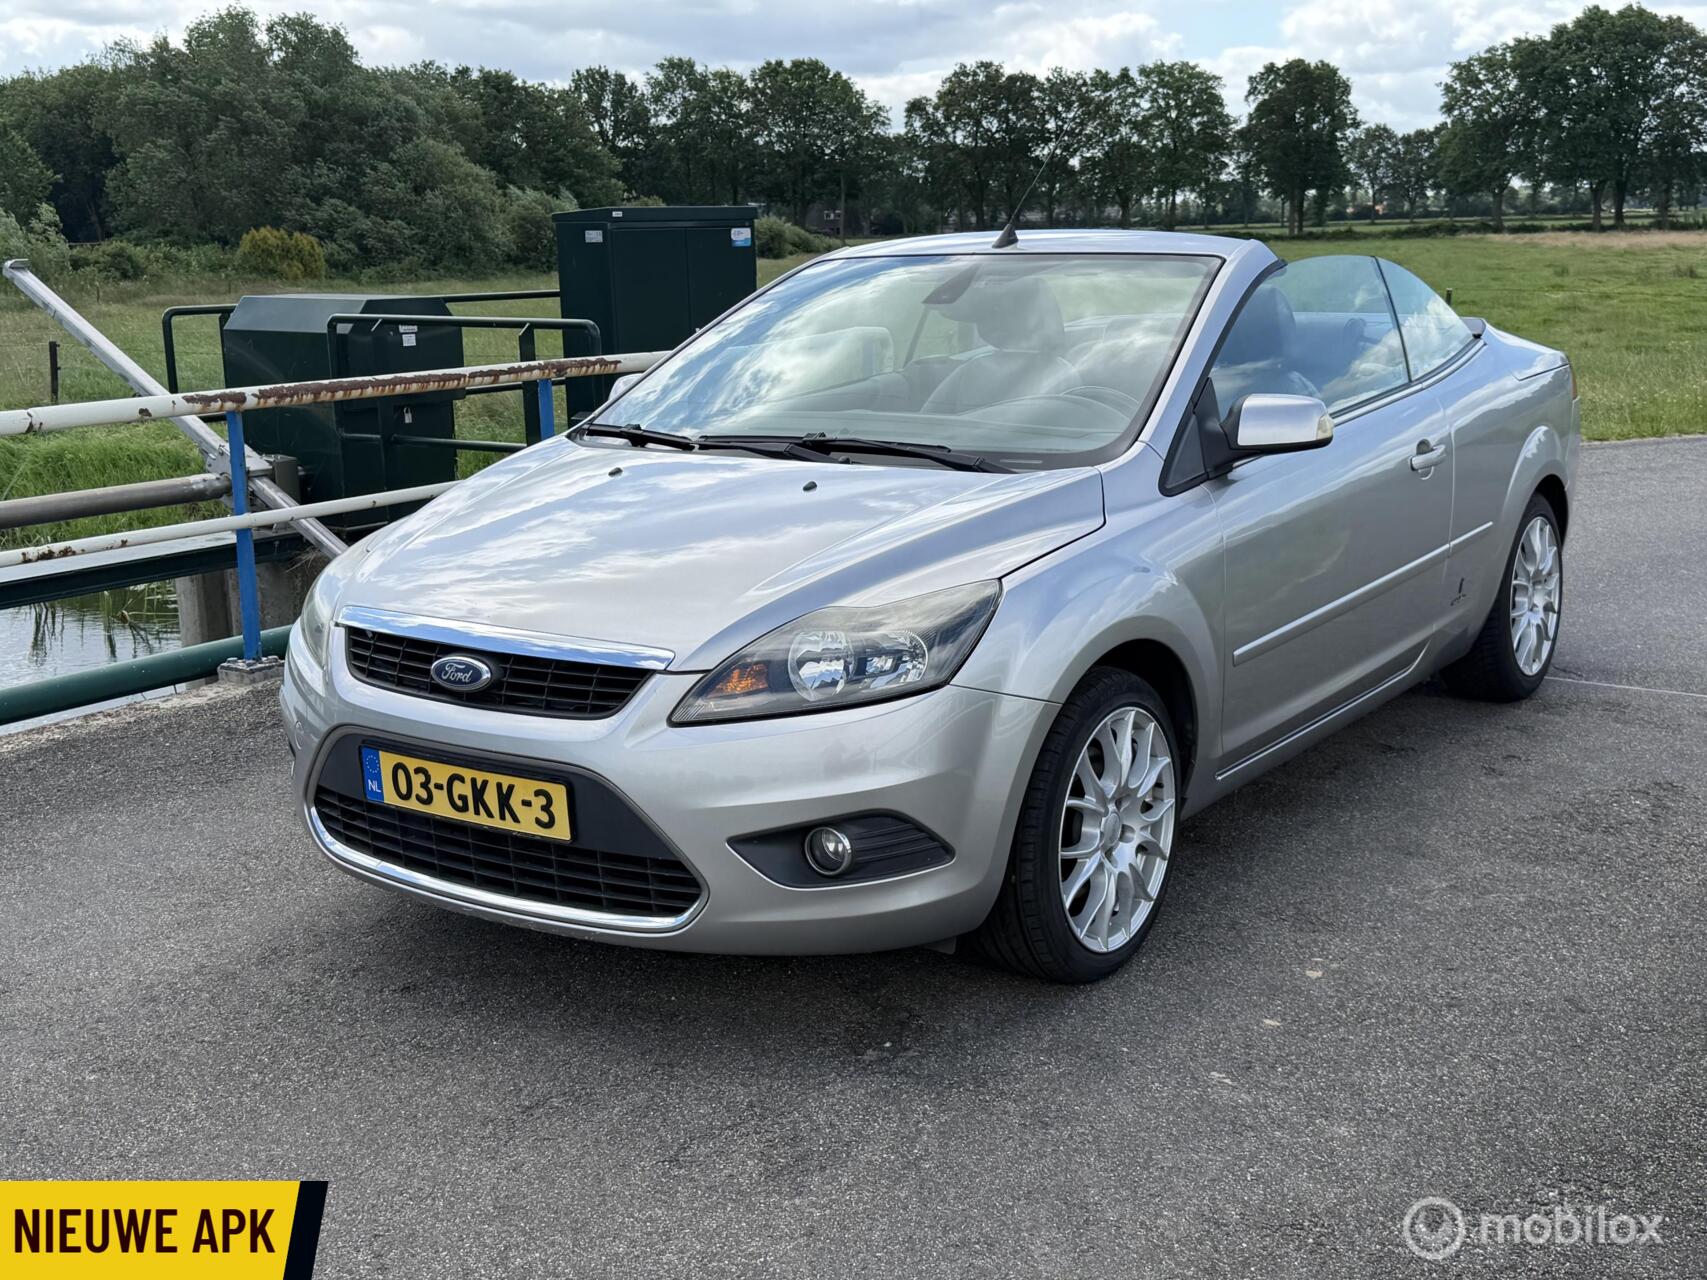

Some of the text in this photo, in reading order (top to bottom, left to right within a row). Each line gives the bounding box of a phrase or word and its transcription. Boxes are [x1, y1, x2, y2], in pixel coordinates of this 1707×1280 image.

[441, 662, 473, 683] Ford
[368, 779, 381, 793] NL
[391, 762, 556, 829] 03-GKK-3
